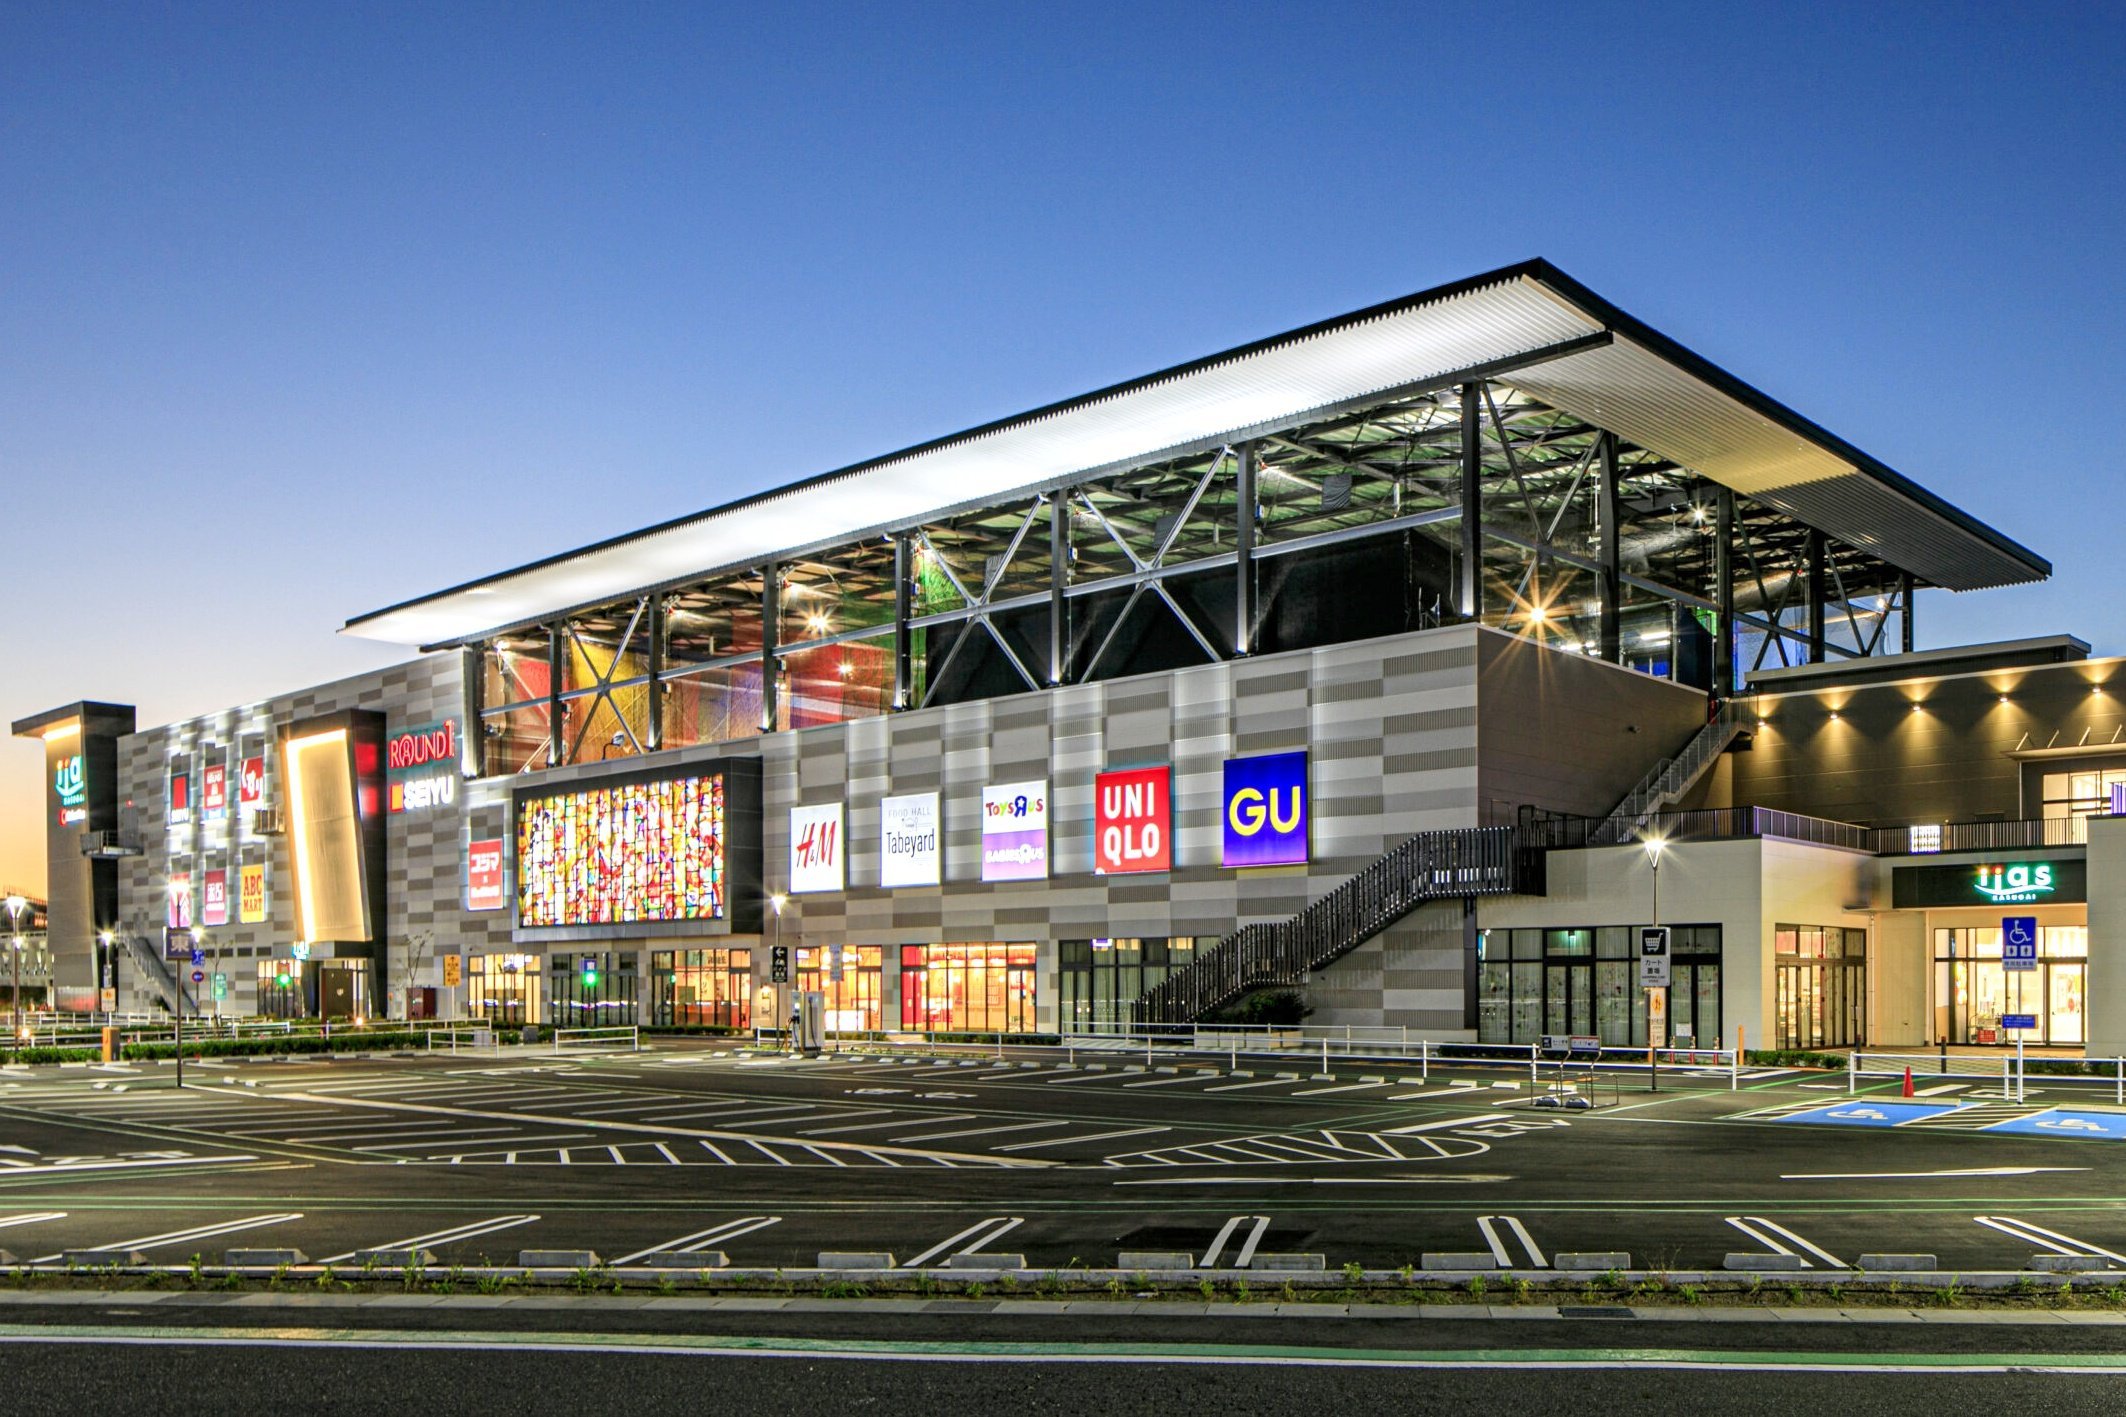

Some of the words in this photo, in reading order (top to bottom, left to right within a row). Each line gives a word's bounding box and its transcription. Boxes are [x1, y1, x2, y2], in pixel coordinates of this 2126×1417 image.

[403, 775, 454, 810] SEIYU
[1103, 782, 1155, 820] UNI
[888, 808, 908, 818] FOOD
[911, 806, 931, 816] HALL
[1229, 786, 1301, 837] GU
[796, 820, 837, 869] H&M
[886, 827, 935, 858] Tabeyard
[1103, 823, 1160, 866] QLO
[471, 851, 500, 873] コジマ
[243, 874, 263, 897] ABC
[1992, 893, 2037, 902] KASUGAI
[243, 898, 263, 912] MART
[1645, 959, 1663, 967] カート
